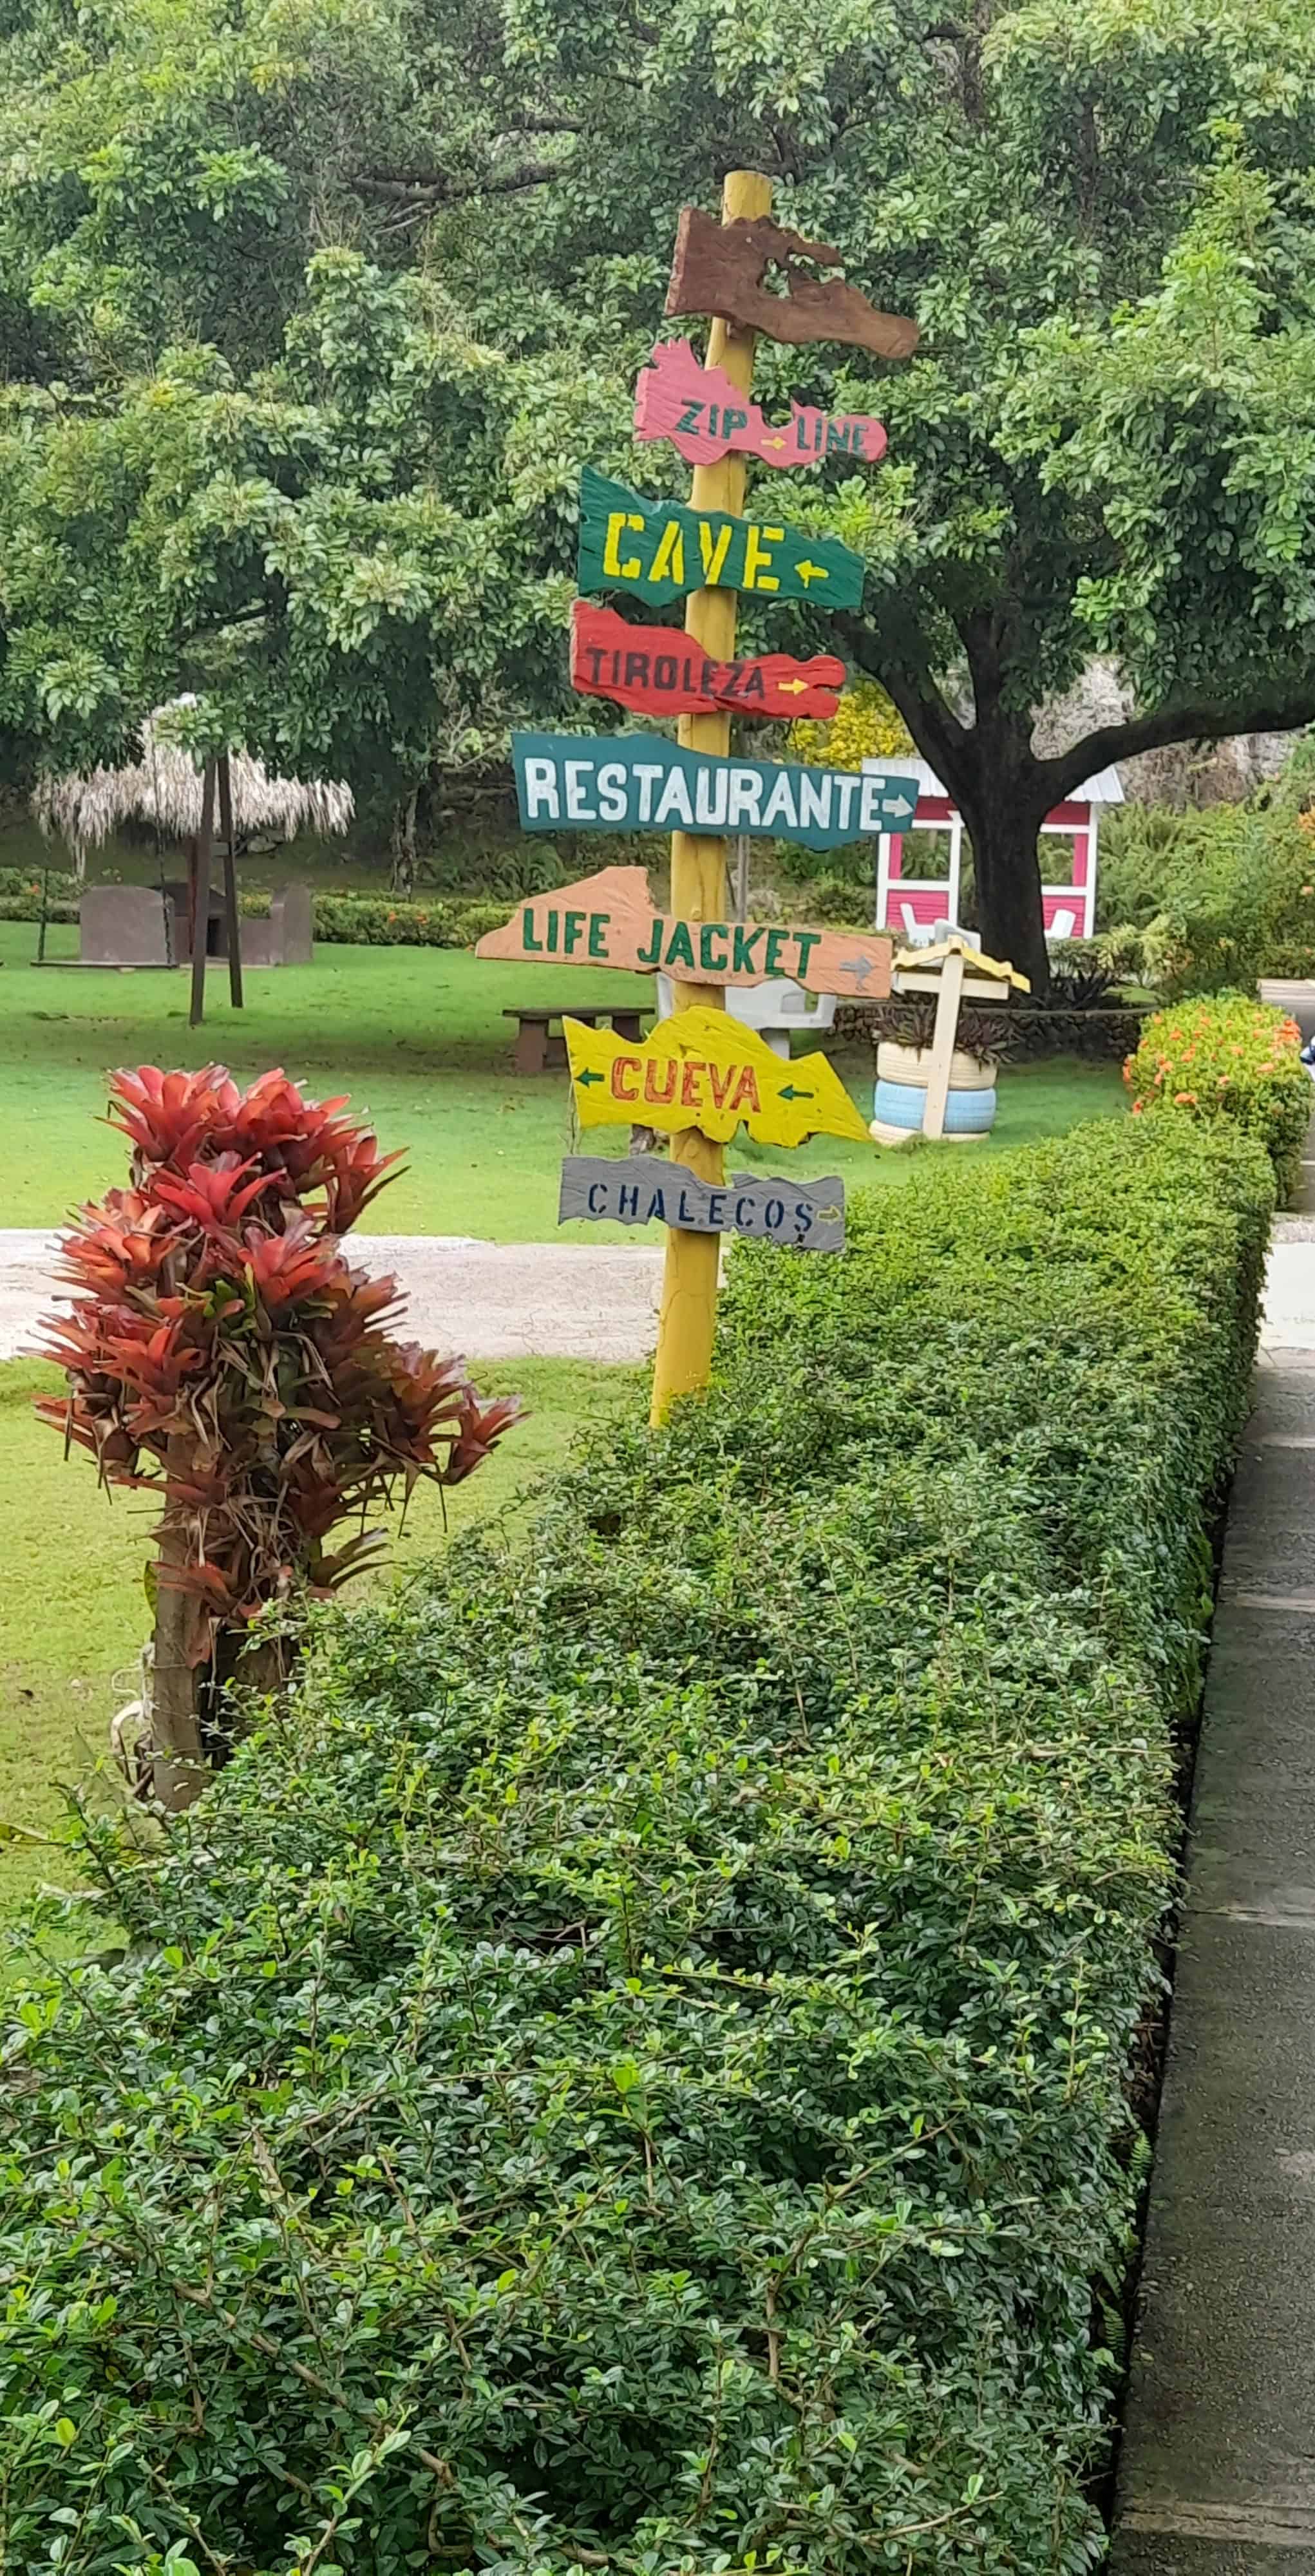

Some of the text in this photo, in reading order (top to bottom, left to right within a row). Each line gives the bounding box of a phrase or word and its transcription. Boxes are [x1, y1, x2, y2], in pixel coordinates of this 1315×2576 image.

[674, 398, 869, 456] ZIP LINE
[603, 512, 785, 591] CAVE
[585, 647, 765, 701] TIROLEZA
[524, 757, 886, 831] RESTAURANTE
[522, 907, 822, 979] LIFE JACKET
[610, 1056, 761, 1113] CUEVA
[589, 1182, 813, 1233] CHALECOS
